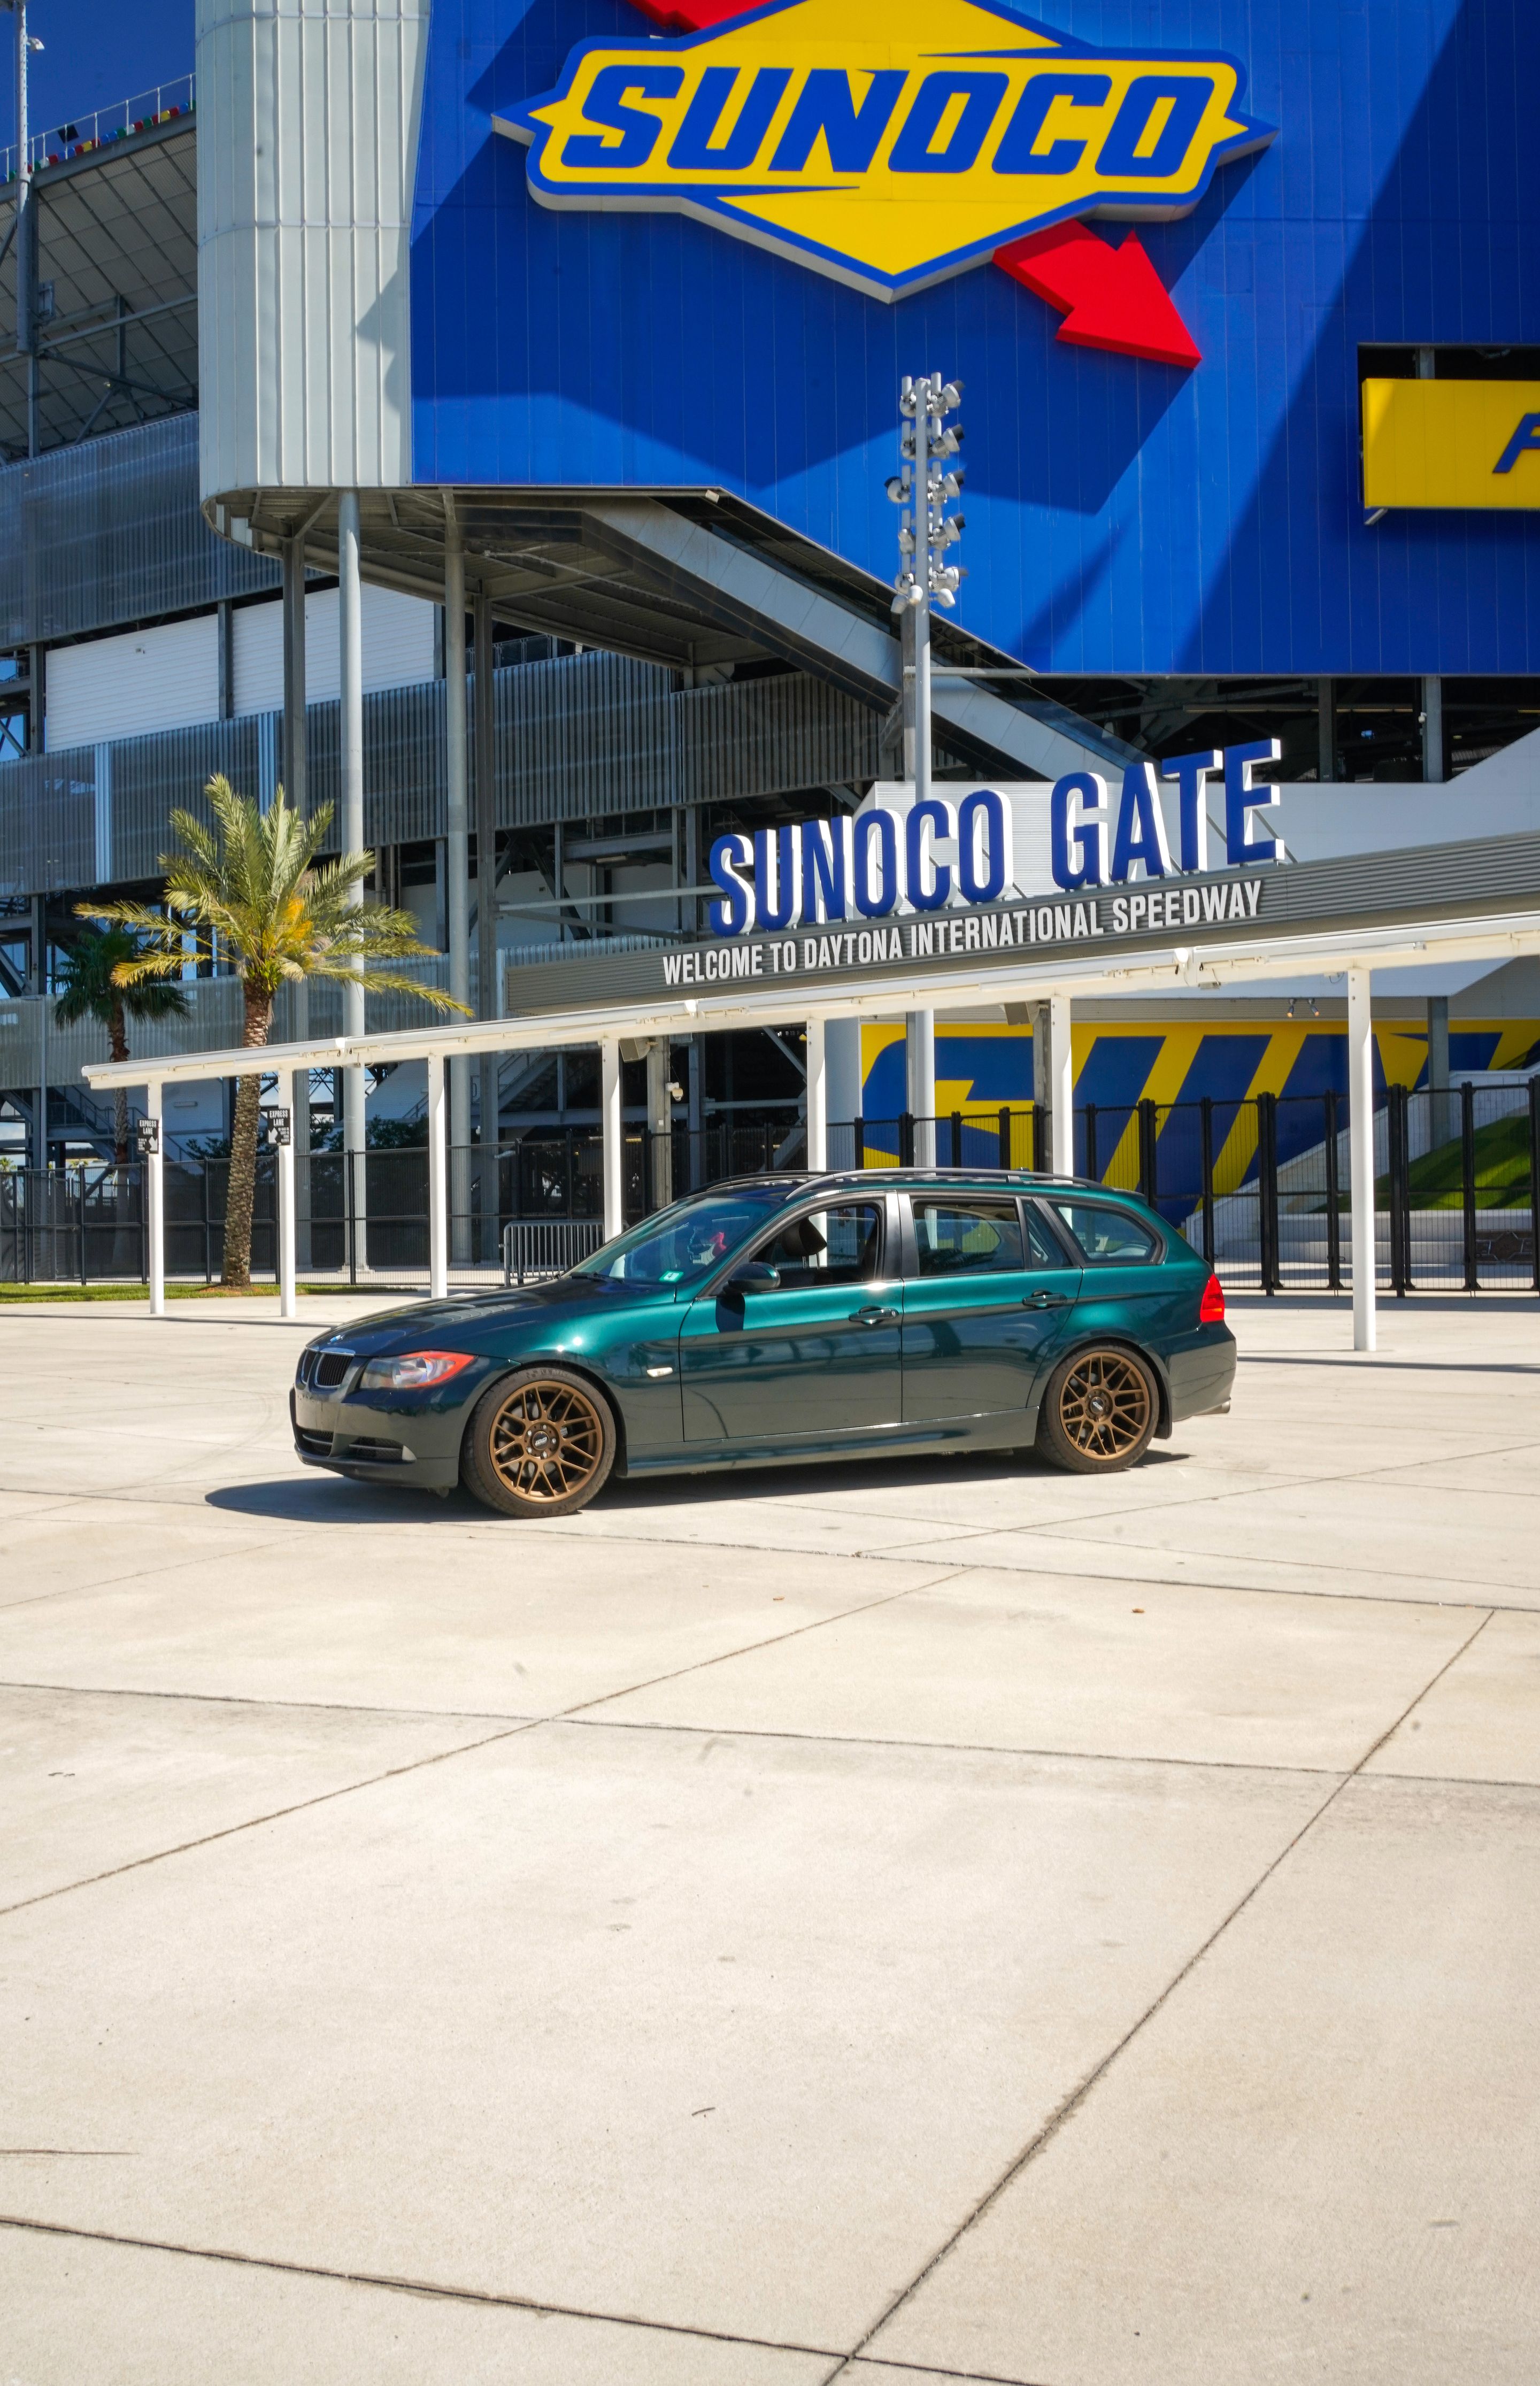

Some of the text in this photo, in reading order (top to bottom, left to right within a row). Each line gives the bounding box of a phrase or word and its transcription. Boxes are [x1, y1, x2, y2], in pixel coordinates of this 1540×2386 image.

[561, 65, 1214, 177] SUNOCO
[709, 738, 1284, 937] SUNOCO GATE
[663, 880, 1261, 985] WELCOME TO DAYTONA INTERNATIONAL SPEEDWAY
[269, 1110, 288, 1119] EXPRESS
[139, 1120, 157, 1128] EXPRESS
[273, 1118, 284, 1127] LANE
[143, 1127, 153, 1135] LANE
